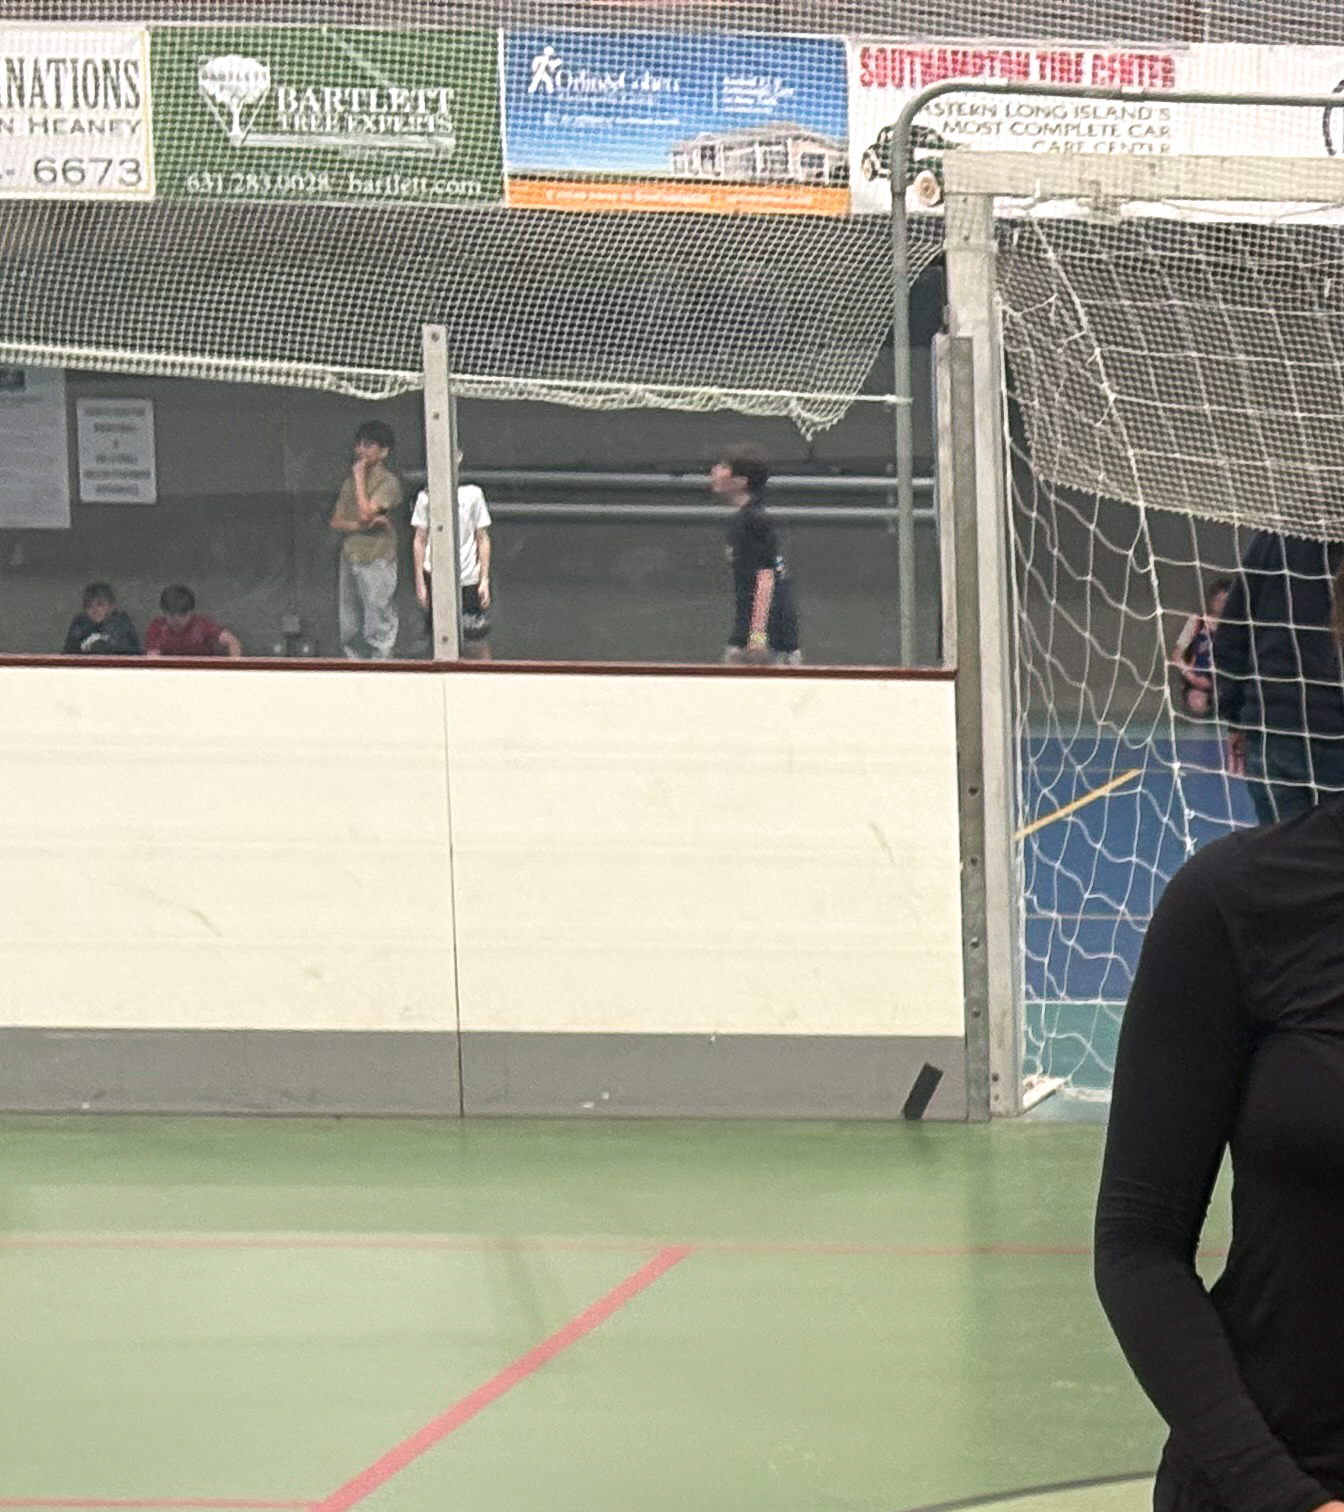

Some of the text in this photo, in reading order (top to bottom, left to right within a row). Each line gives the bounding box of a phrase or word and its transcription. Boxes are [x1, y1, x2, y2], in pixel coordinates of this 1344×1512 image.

[859, 46, 1176, 89] SOUTHAMPTON TIRE CENTER
[277, 86, 455, 114] BARTLETT
[921, 102, 998, 119] ASTERN
[1005, 103, 1068, 120] LONG
[28, 118, 142, 135] HEANEY
[942, 120, 1171, 138] MOST COMPLETE CAR
[33, 157, 143, 187] 6673
